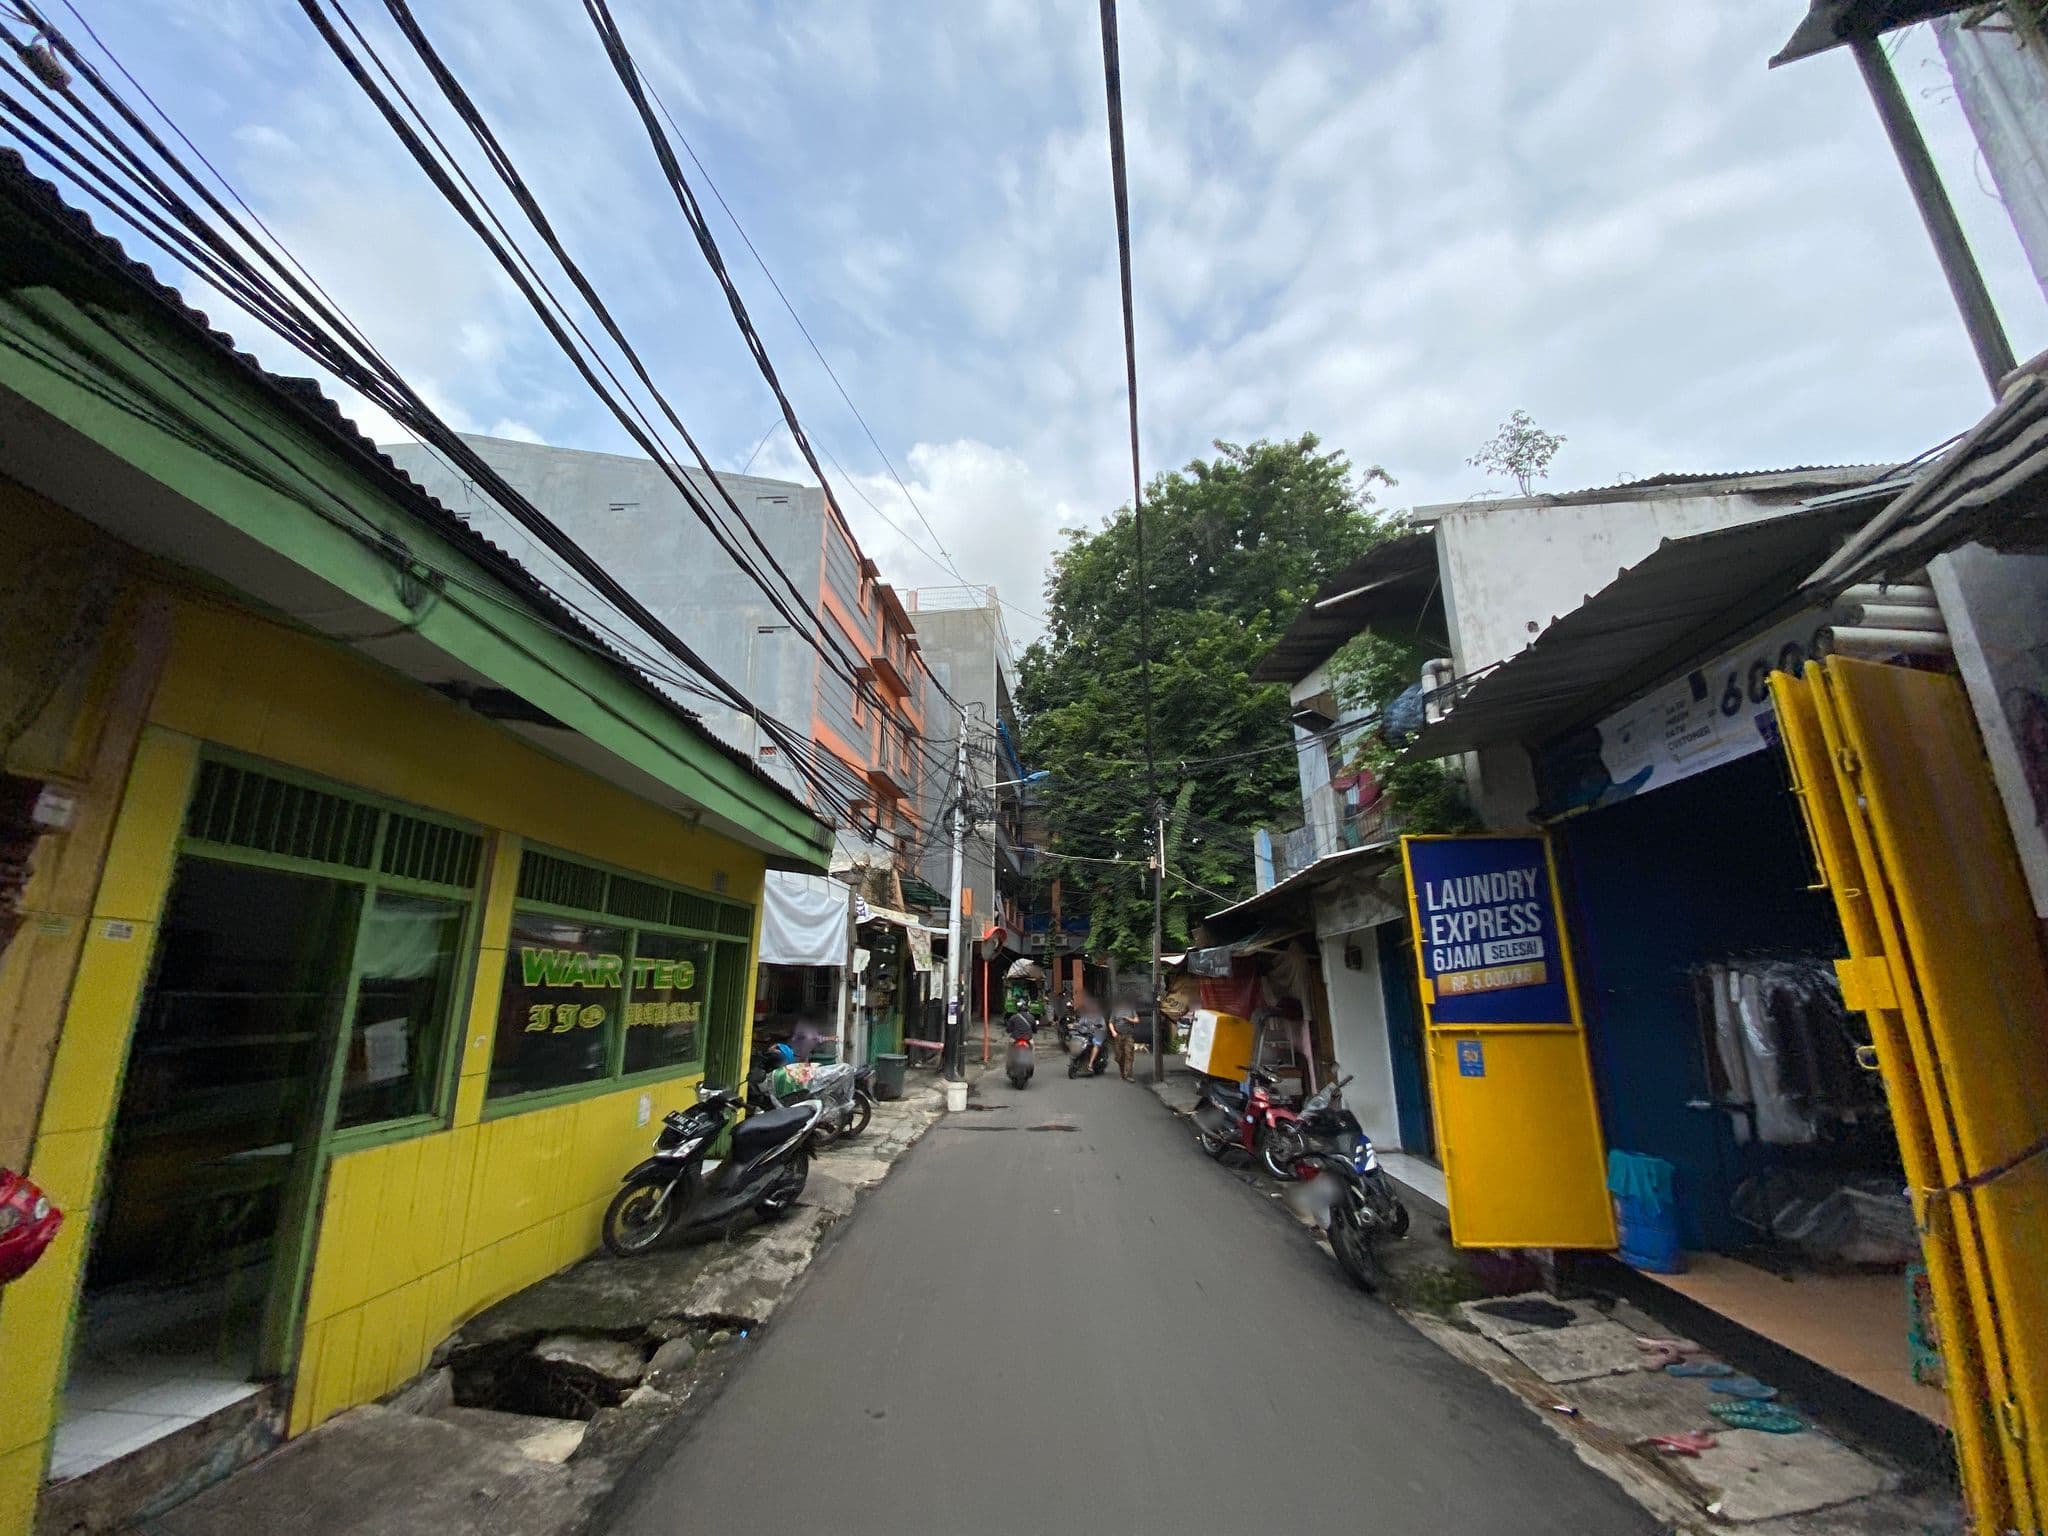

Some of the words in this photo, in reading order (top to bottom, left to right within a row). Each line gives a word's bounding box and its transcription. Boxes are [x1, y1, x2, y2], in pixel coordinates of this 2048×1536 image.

[1426, 867, 1538, 911] LAUNDRY
[1430, 902, 1543, 946] EXPRESS
[521, 947, 622, 987] WAR
[632, 957, 696, 990] TEG
[1433, 944, 1482, 971] 6JAM
[1490, 940, 1538, 961] SELESAI
